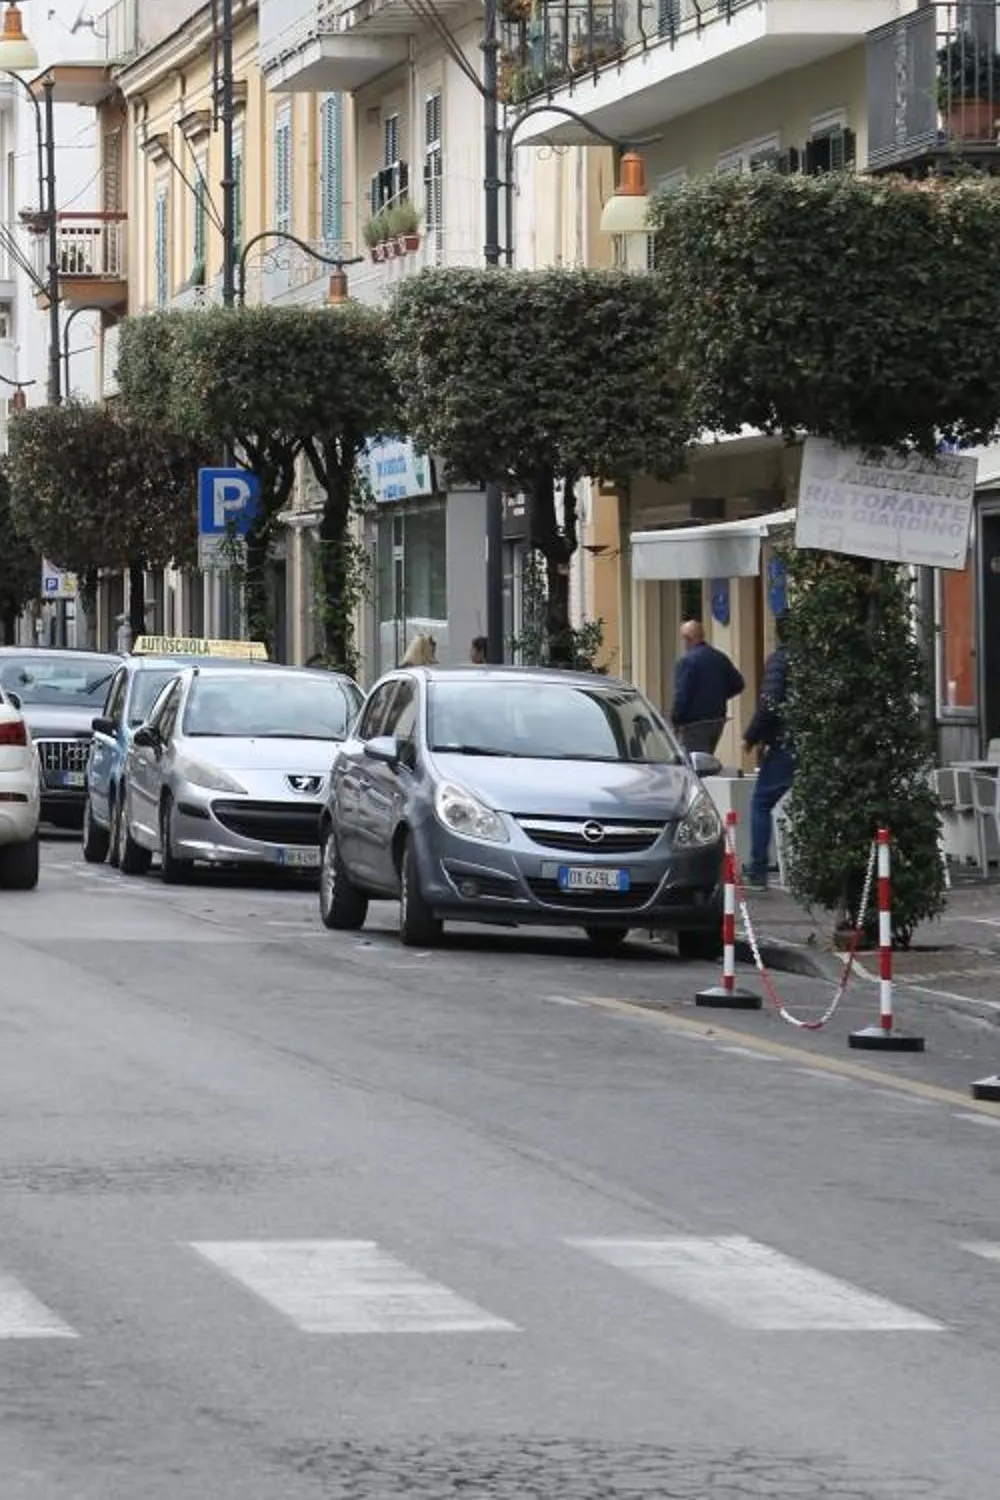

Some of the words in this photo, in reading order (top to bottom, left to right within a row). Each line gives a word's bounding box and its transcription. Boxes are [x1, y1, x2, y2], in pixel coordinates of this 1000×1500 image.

[213, 478, 250, 527] P
[806, 482, 967, 522] RISTORANTE
[852, 508, 963, 537] GIARDINO
[141, 637, 212, 654] AUTOSCUOLA
